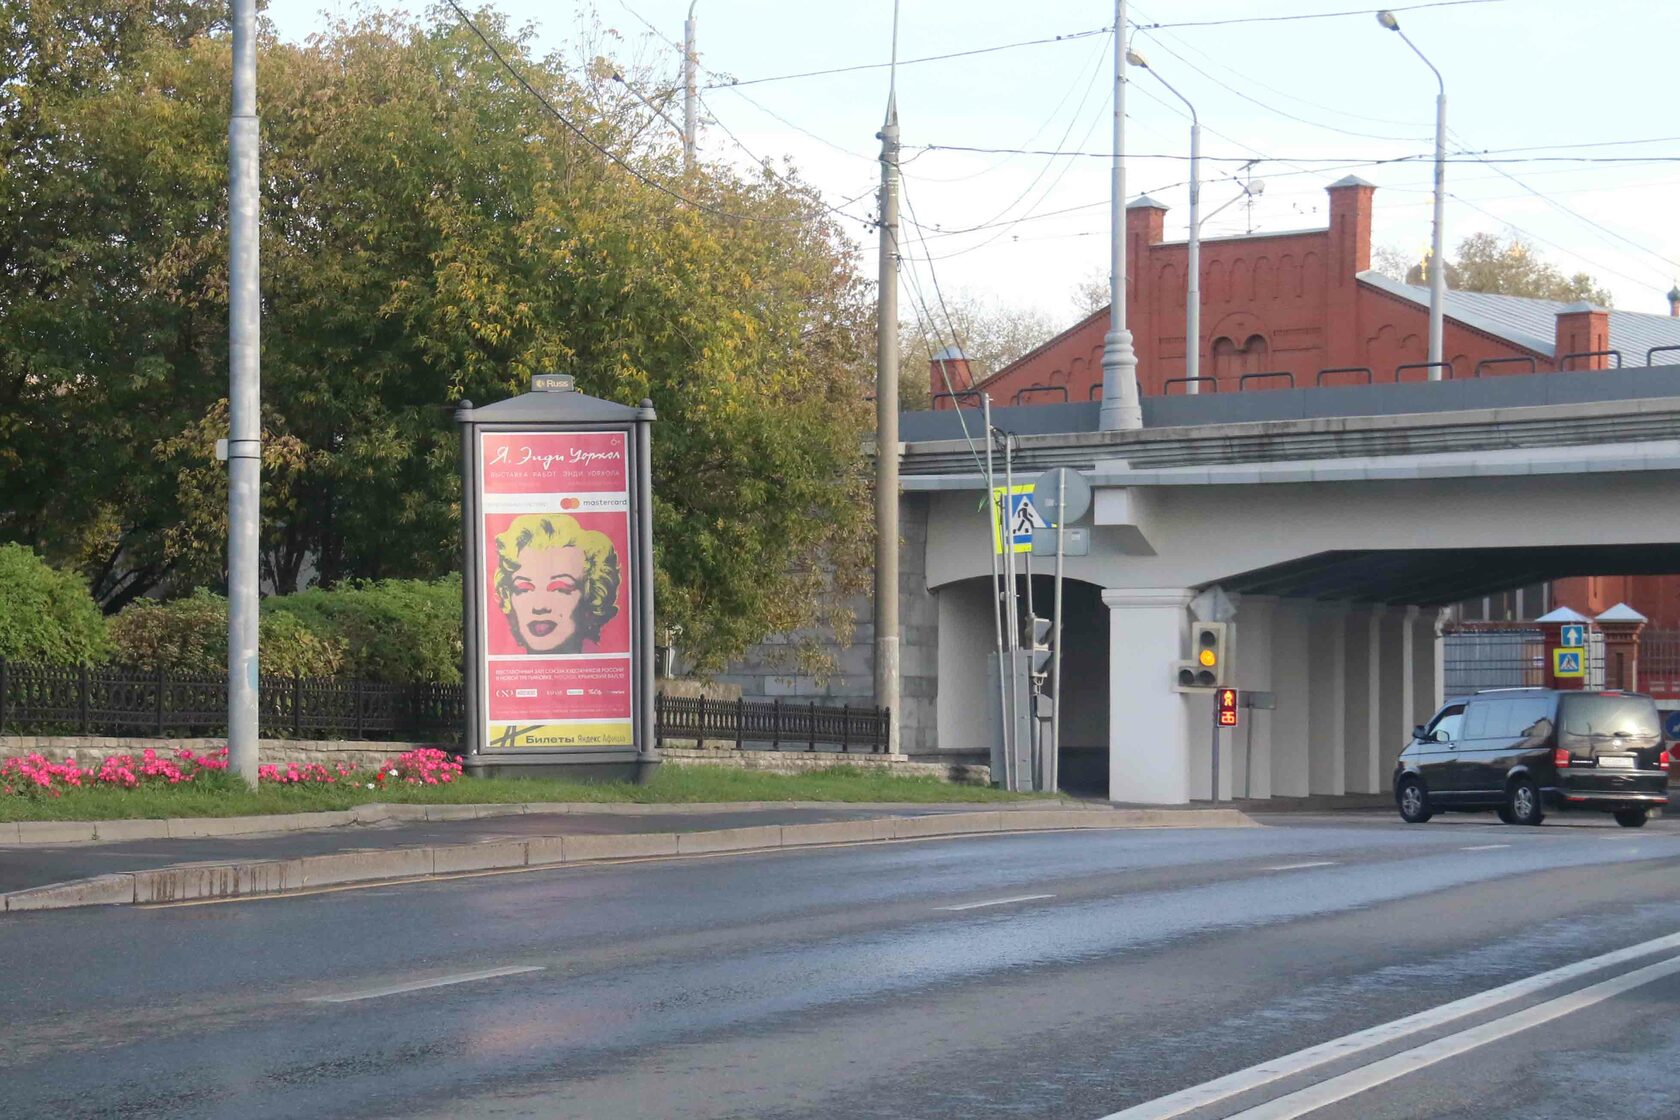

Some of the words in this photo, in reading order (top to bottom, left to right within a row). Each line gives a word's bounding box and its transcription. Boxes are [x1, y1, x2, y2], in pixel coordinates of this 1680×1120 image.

[546, 379, 569, 388] Russ
[516, 446, 565, 470] Энди
[568, 447, 620, 466] Уорхол
[525, 735, 575, 744] Билеты
[577, 734, 601, 743] Яндекс
